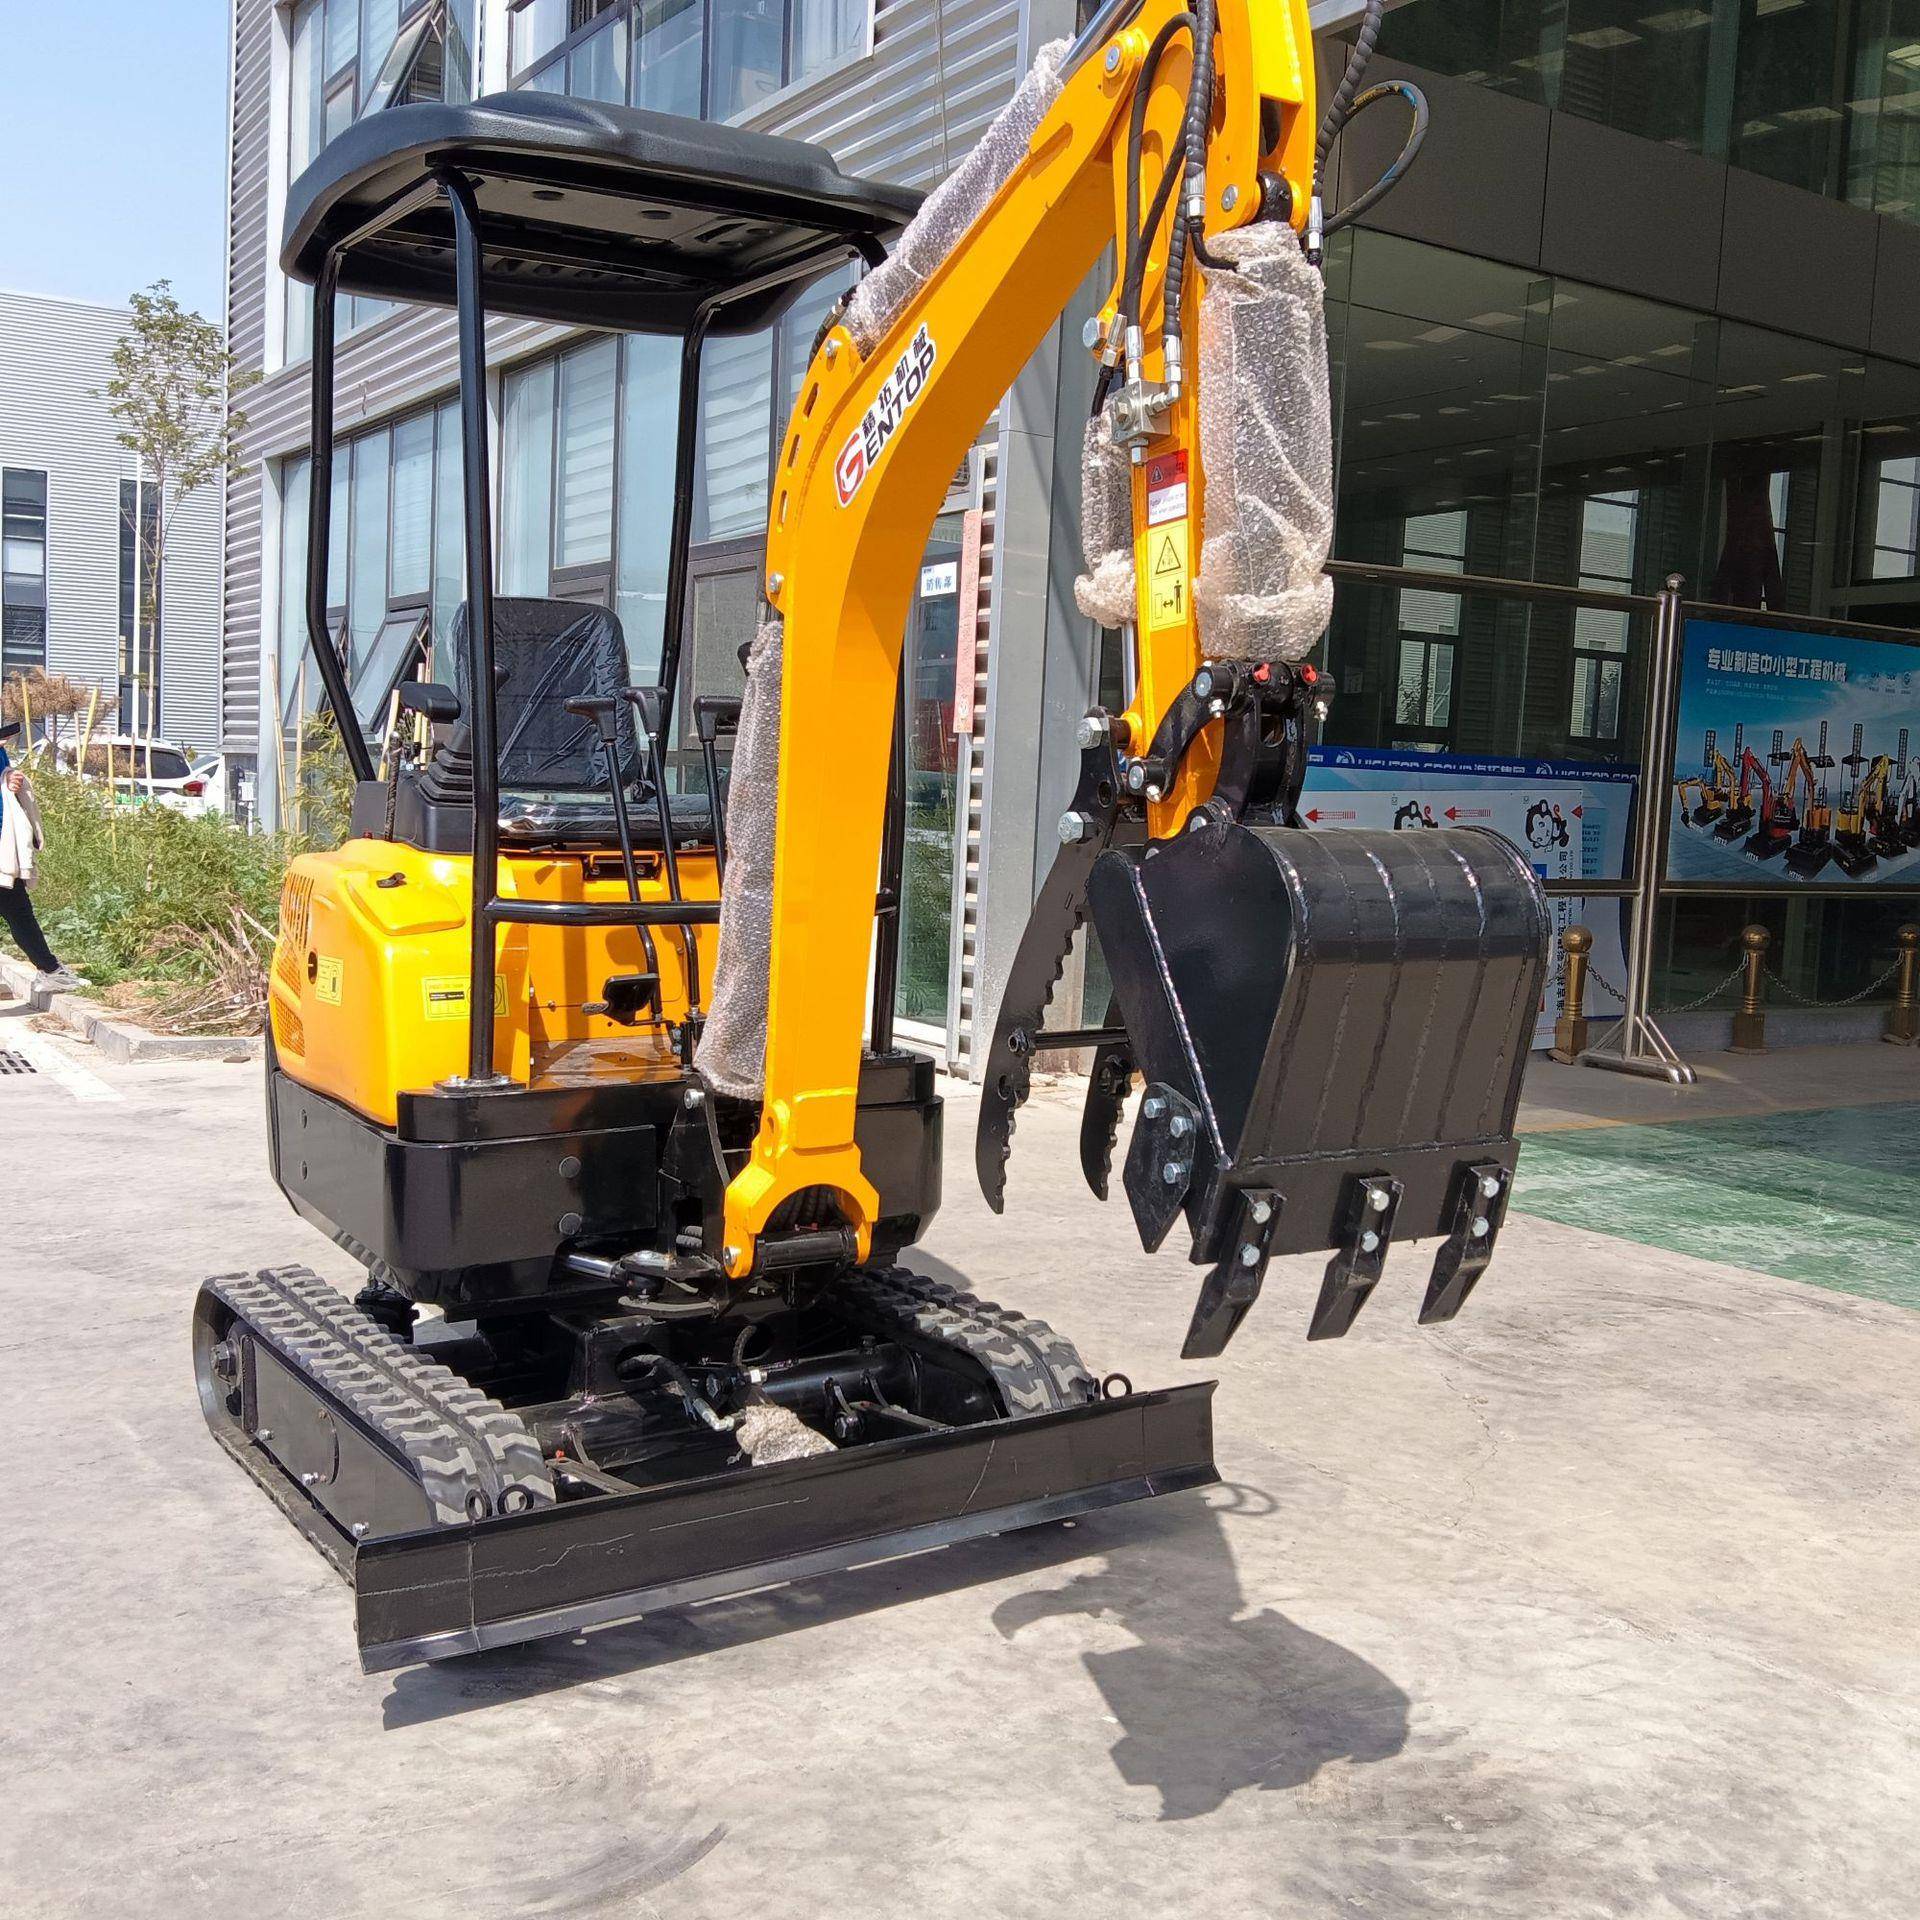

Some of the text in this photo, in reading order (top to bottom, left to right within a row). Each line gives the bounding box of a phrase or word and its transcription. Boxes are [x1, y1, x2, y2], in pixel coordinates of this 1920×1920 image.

[1707, 647, 1848, 683] 专业制造中小型工程机械
